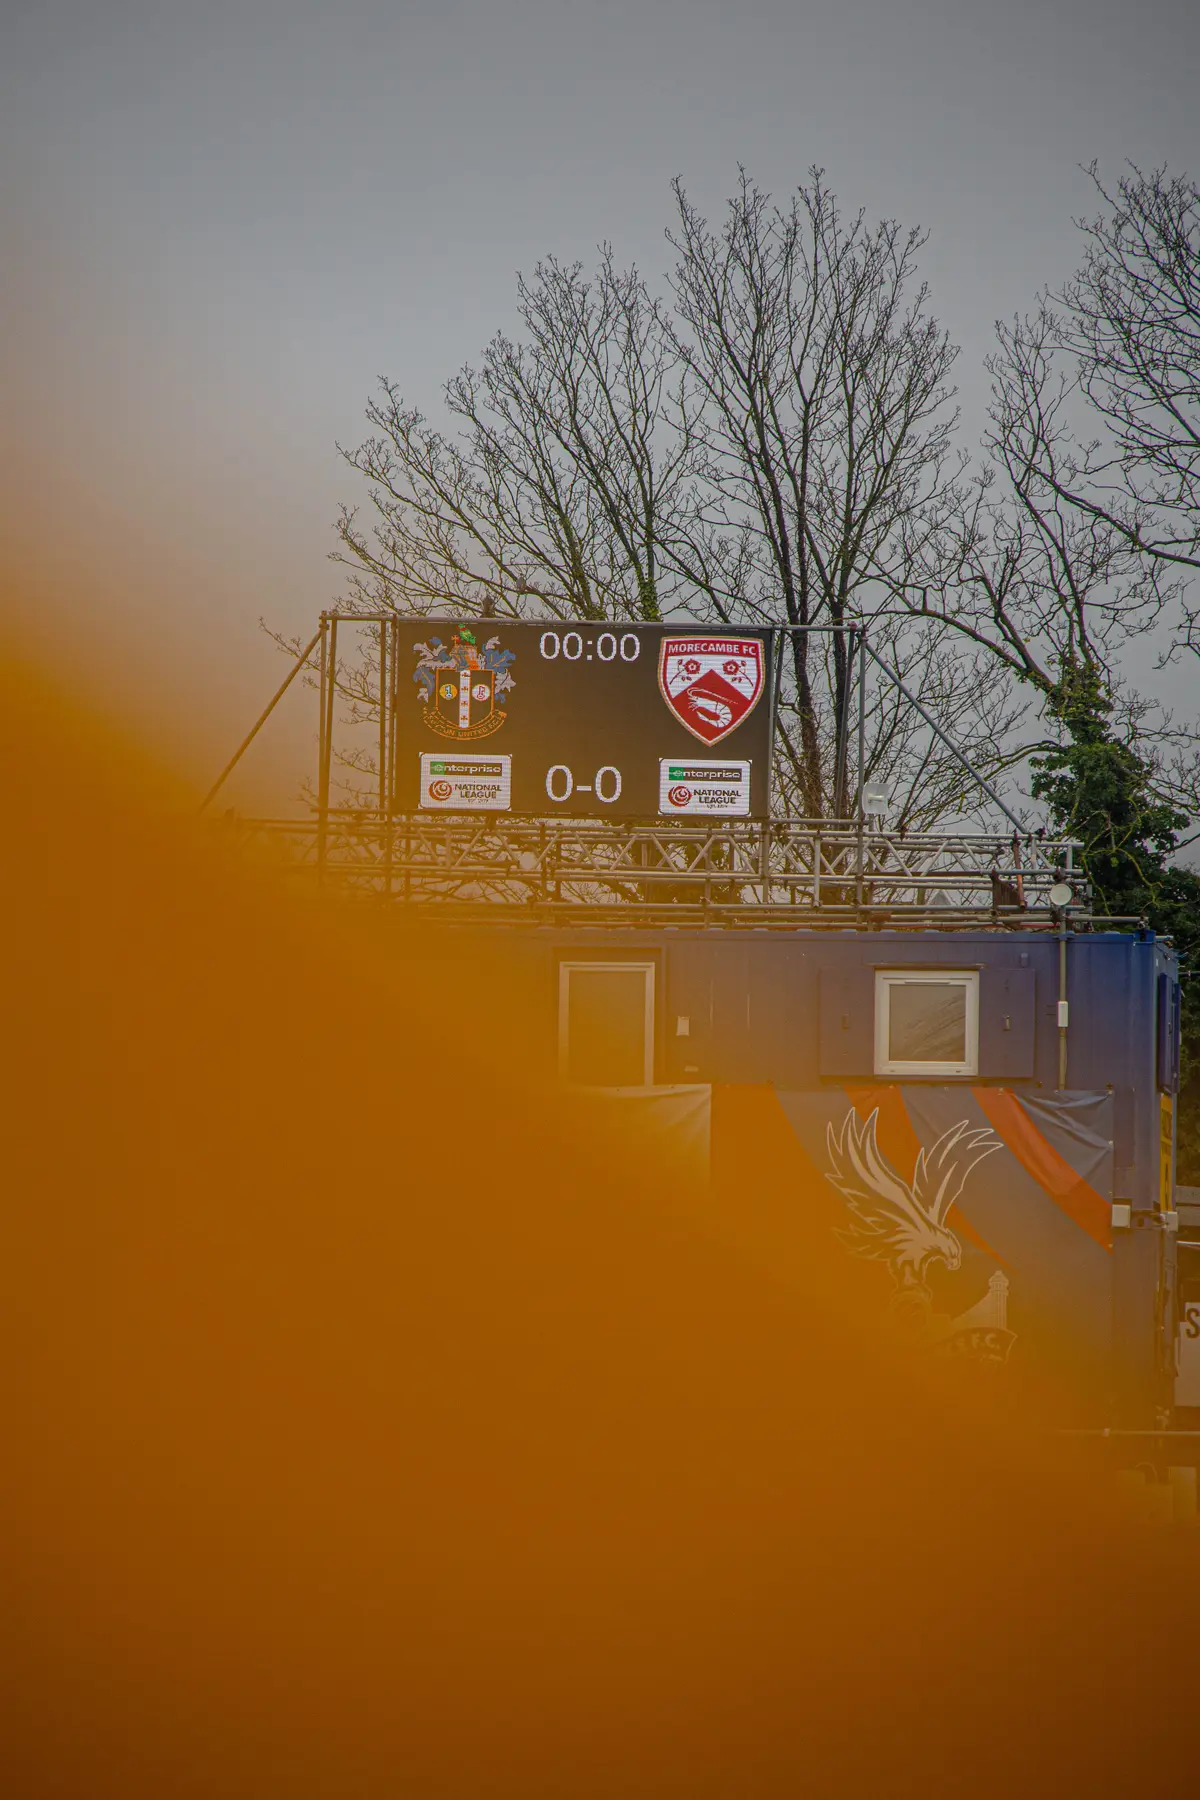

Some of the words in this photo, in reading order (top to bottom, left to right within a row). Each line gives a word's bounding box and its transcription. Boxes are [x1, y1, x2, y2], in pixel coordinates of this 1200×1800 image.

[539, 632, 640, 661] 00:00
[668, 643, 739, 654] MORECAMBE
[742, 645, 756, 655] FC
[432, 764, 501, 774] enterprise
[671, 769, 740, 779] enterprise
[454, 783, 502, 792] NATIONAL
[545, 765, 622, 803] 0-0
[460, 791, 497, 799] LEAGUE
[693, 789, 742, 797] NATIONAL
[698, 796, 736, 804] LEAGUE
